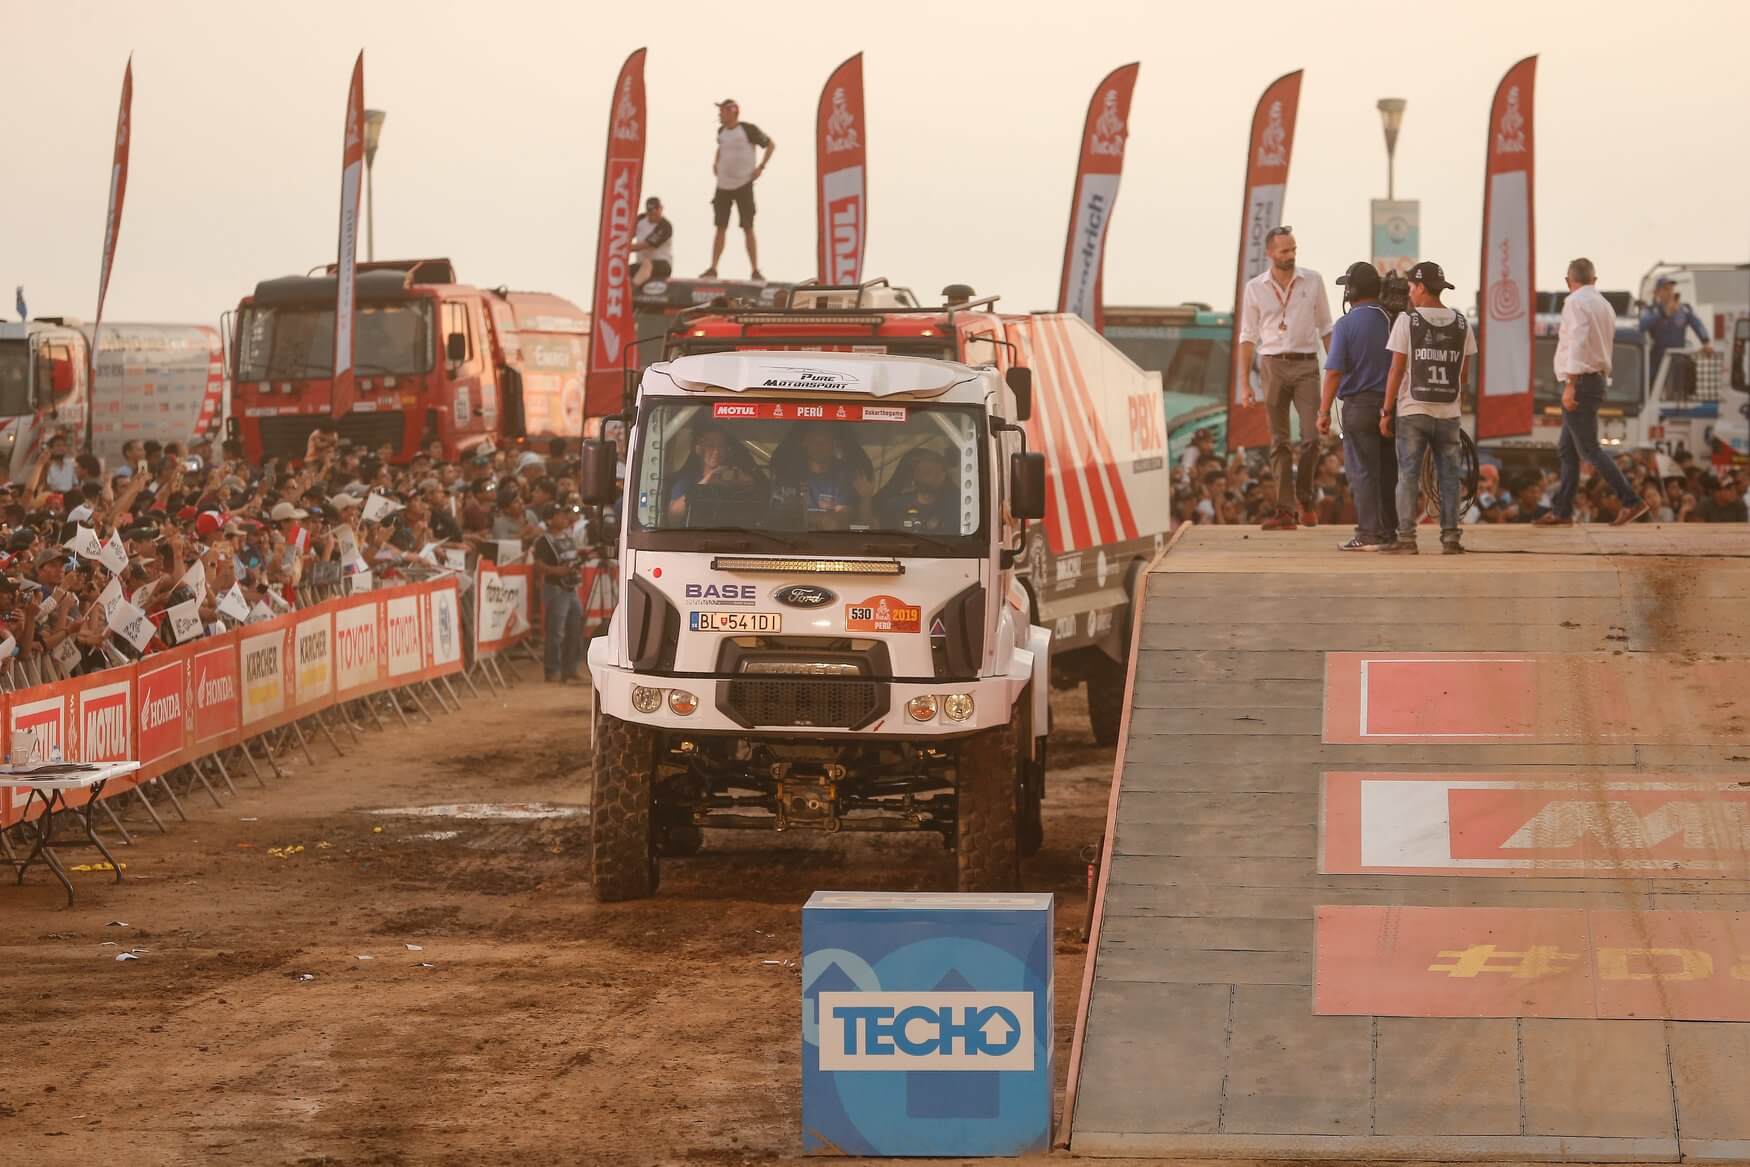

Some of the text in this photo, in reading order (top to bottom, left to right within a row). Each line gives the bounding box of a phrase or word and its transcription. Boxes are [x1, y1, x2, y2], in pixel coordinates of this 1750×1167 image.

[607, 168, 629, 318] HONDA
[1415, 348, 1460, 362] PODIUM TV
[1428, 365, 1449, 384] 11
[717, 405, 756, 416] MOTUL
[797, 405, 823, 417] PERÚ
[685, 584, 756, 599] BASE
[787, 588, 825, 603] Ford
[700, 613, 719, 630] BL
[851, 608, 872, 620] 530
[892, 608, 918, 622] 2019
[390, 616, 418, 656] TOYOTA
[338, 624, 375, 670] TOYOTA
[205, 676, 235, 705] HONDA
[150, 692, 181, 728] HONDA
[86, 704, 126, 762] MOTUL
[832, 1005, 1021, 1057] TECHO
